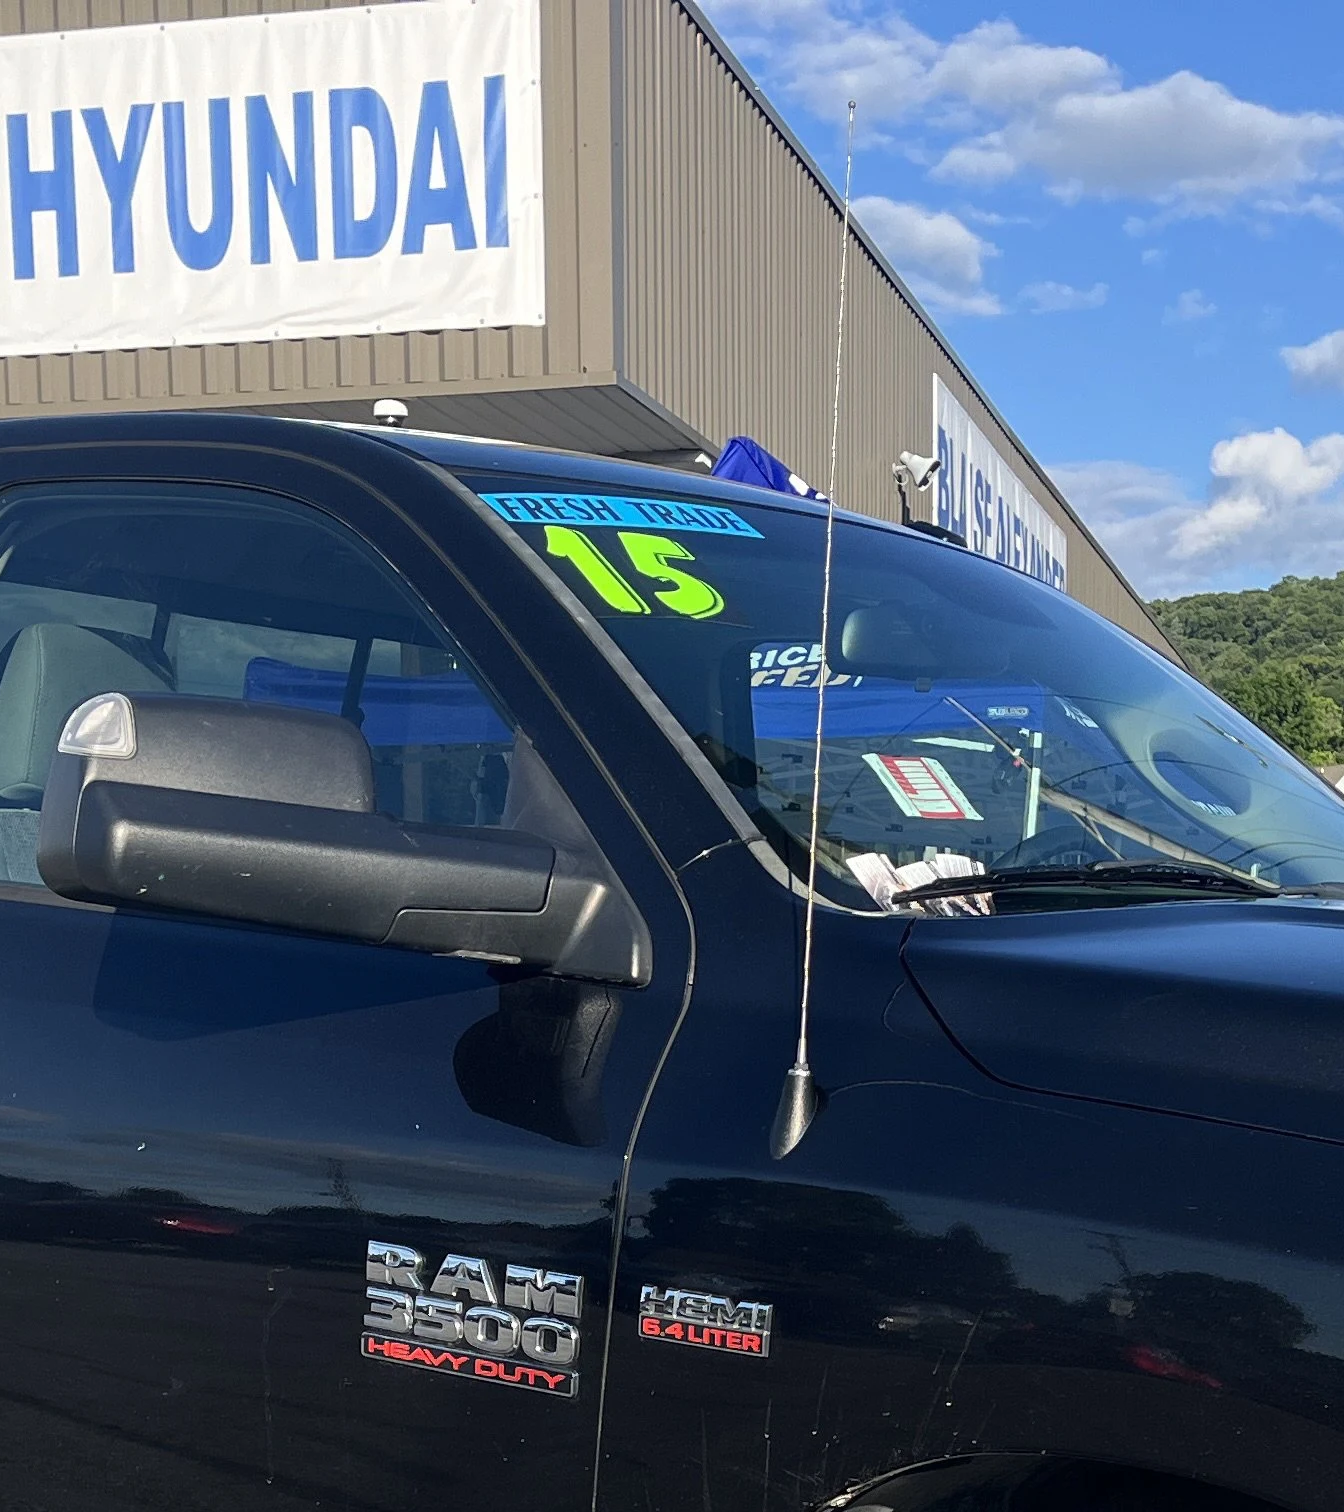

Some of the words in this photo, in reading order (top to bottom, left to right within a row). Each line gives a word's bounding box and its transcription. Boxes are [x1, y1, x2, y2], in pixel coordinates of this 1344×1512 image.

[6, 74, 510, 281] HYUNDAI
[502, 497, 623, 521] FRESH
[627, 500, 750, 532] TRADE
[938, 424, 991, 555] BLAISE
[544, 525, 725, 619] 15
[366, 1240, 584, 1319] RAM
[640, 1285, 773, 1332] HEMI
[363, 1286, 582, 1366] 3500
[367, 1337, 470, 1371] HEAVY
[474, 1359, 567, 1390] DUTY
[642, 1317, 685, 1340] 6.4
[687, 1324, 762, 1353] LITER
